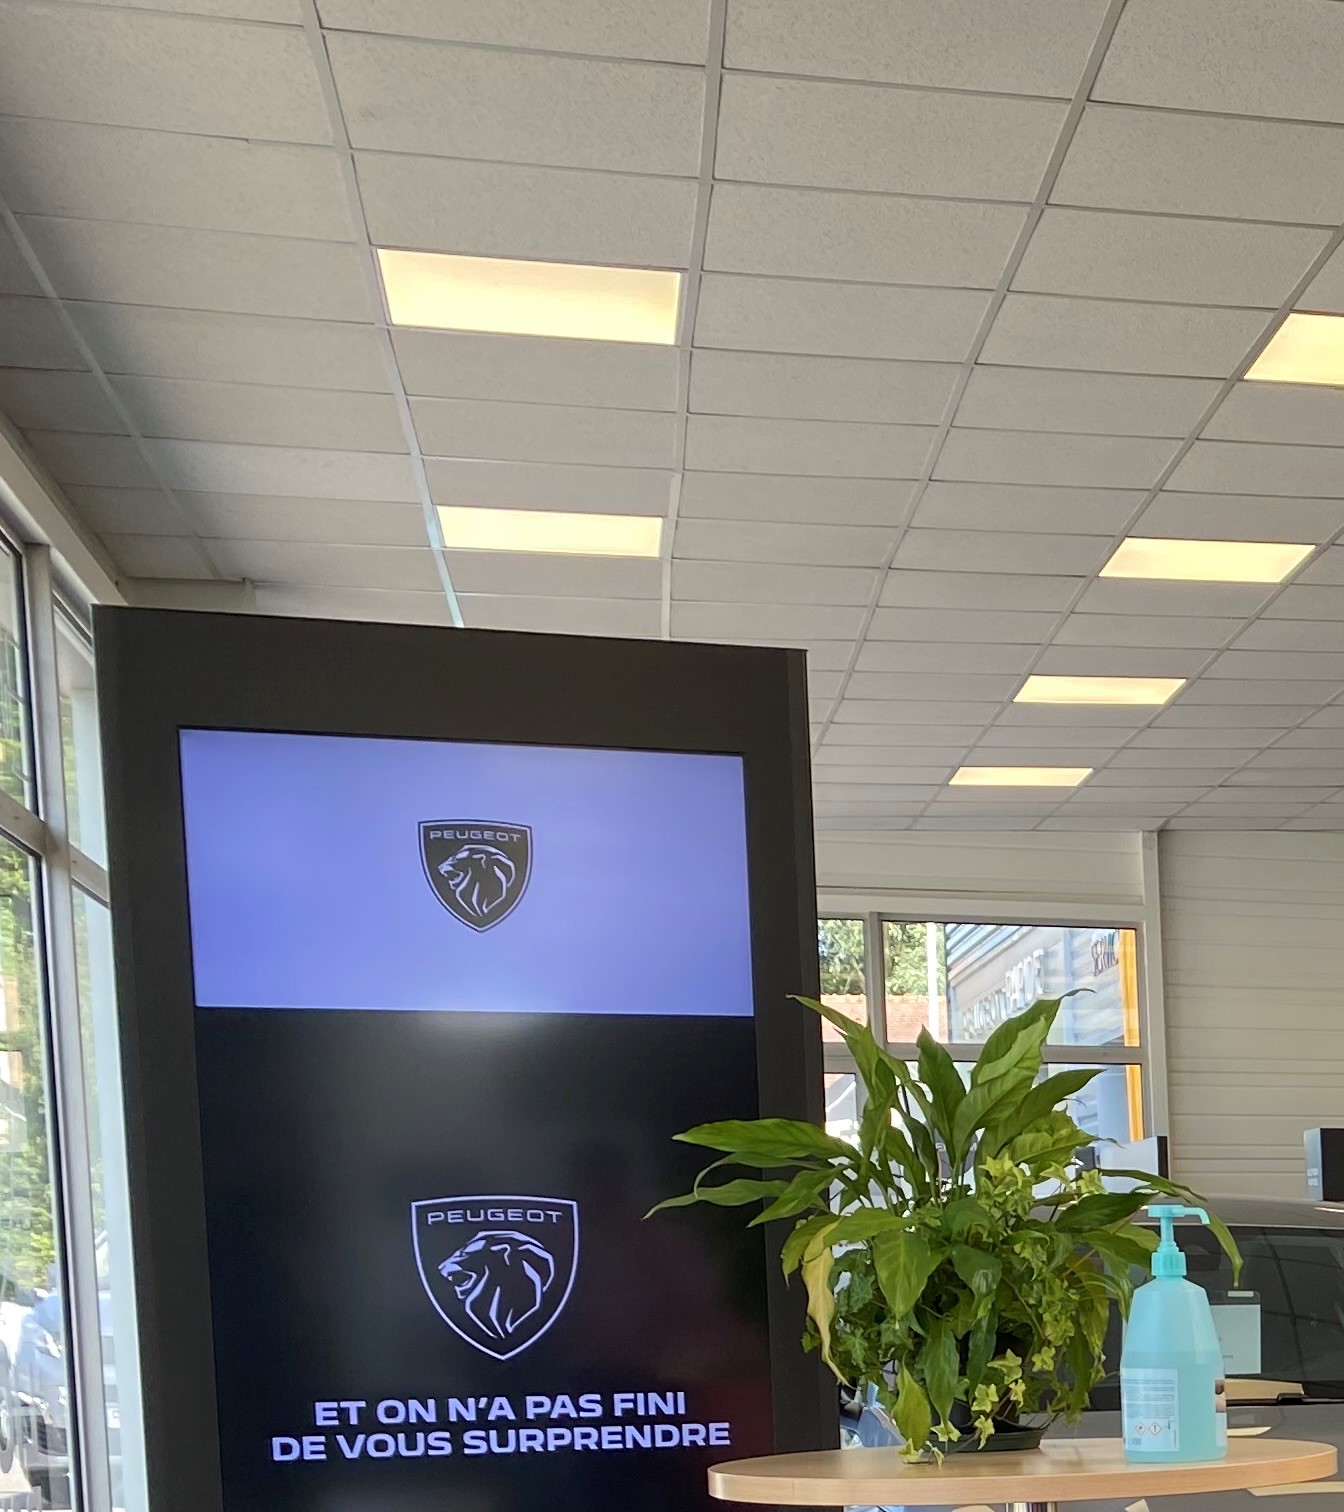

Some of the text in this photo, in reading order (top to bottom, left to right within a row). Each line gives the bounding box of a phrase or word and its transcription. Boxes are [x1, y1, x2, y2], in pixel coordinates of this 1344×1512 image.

[429, 829, 522, 843] PEUGEOT
[427, 1209, 563, 1225] PEUGEOT
[314, 1391, 687, 1427] ET ON N'A PAS FINI
[270, 1421, 731, 1462] DE VOUS SURPRENDRE
